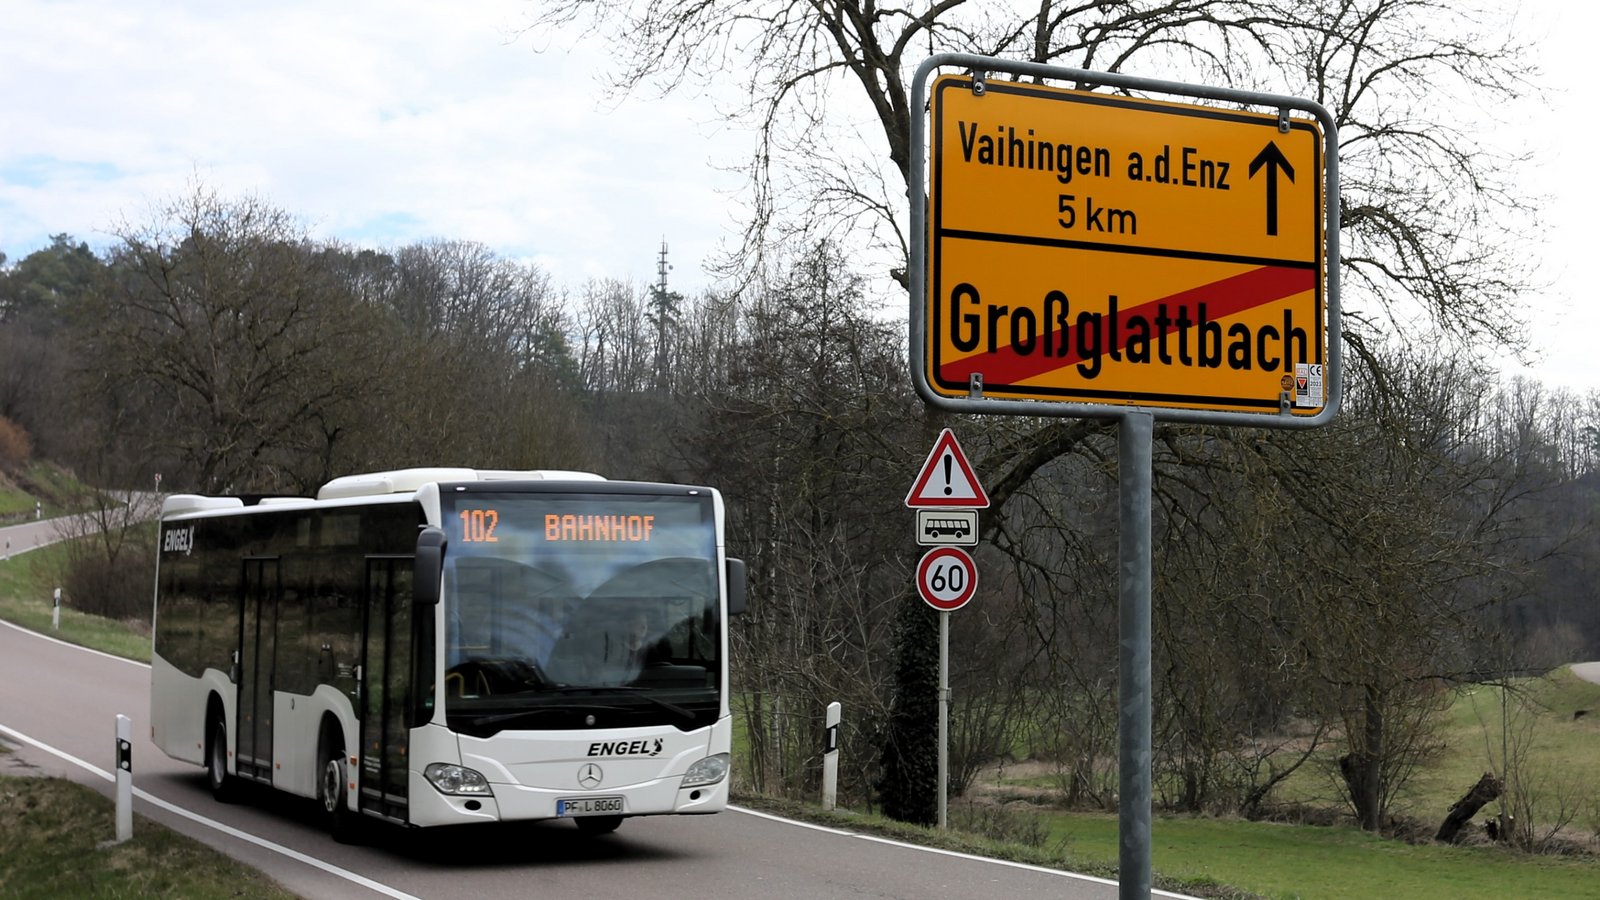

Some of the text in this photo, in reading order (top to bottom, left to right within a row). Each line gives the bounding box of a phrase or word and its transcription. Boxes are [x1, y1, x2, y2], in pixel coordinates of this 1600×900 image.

[958, 121, 1230, 190] Vaihingen a.d.Enz
[1058, 194, 1137, 235] 5 km
[950, 282, 1307, 380] Großglattbach
[164, 528, 188, 551] ENGEL
[460, 509, 654, 542] 102 BAHNHOF
[931, 564, 963, 592] 60
[587, 741, 650, 756] ENGEL
[594, 799, 620, 811] 8060
